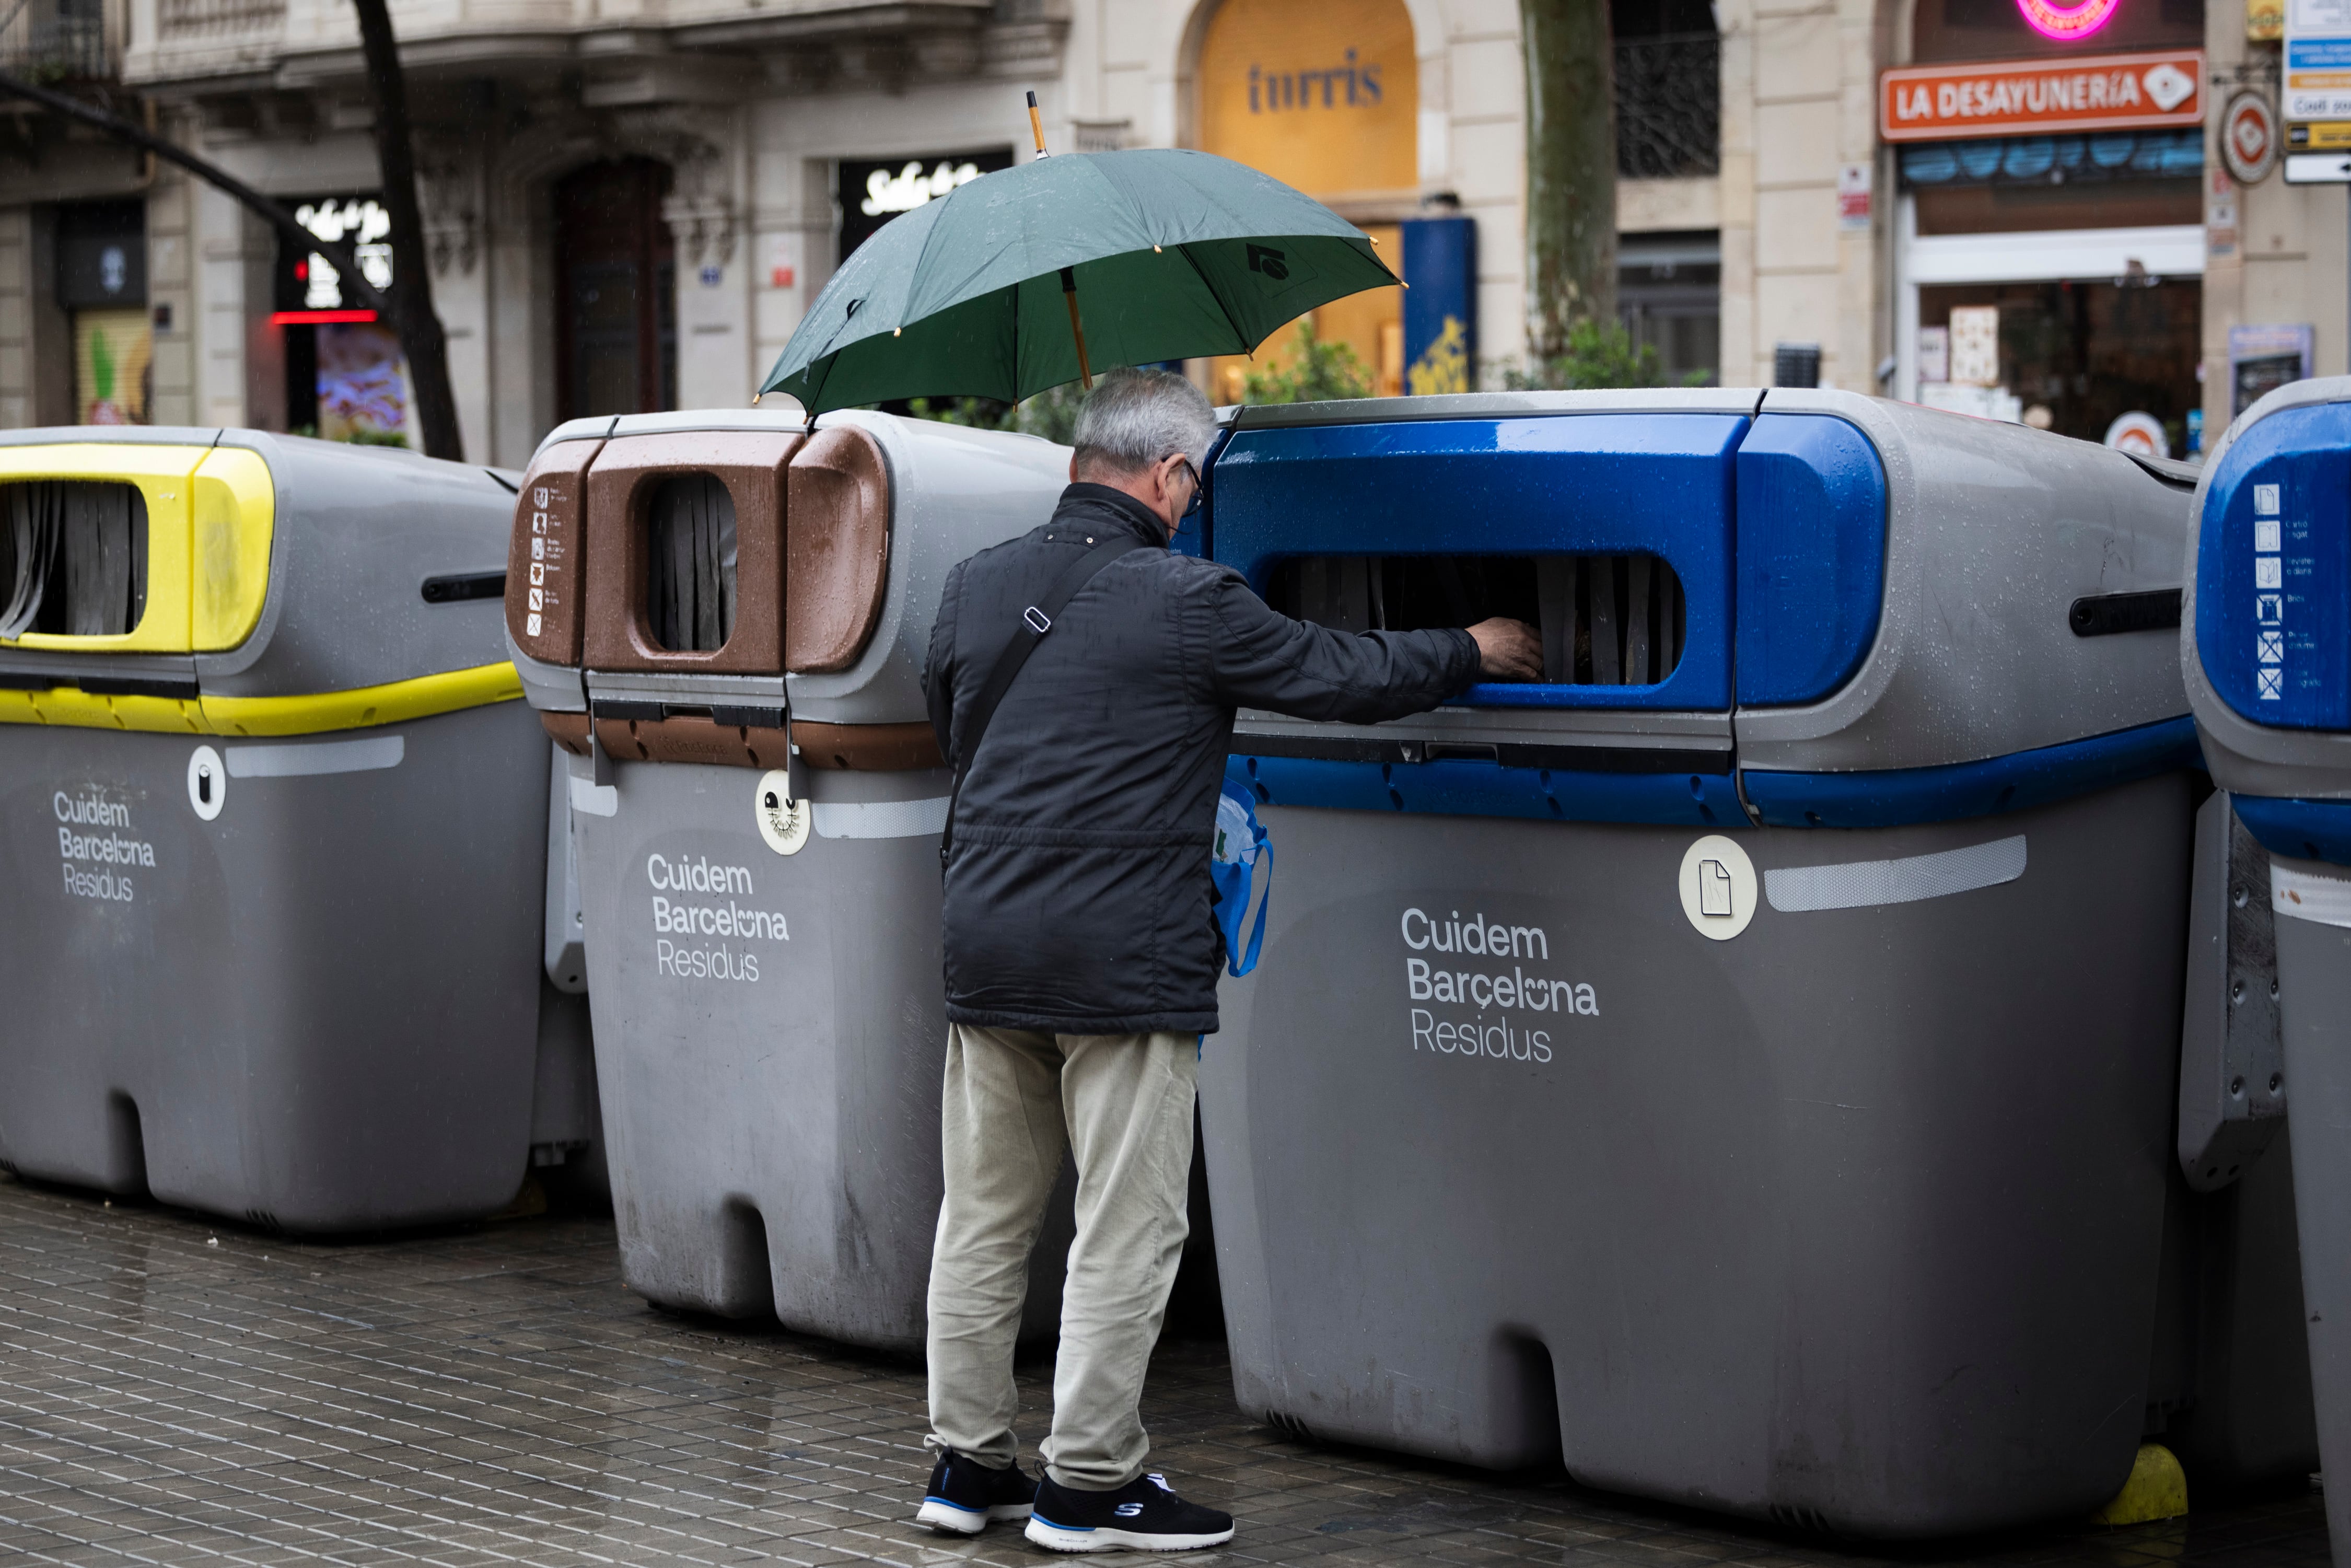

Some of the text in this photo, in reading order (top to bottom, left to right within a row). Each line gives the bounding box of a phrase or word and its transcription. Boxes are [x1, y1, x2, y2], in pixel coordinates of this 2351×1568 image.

[1896, 83, 1933, 121] LA
[54, 791, 130, 828] Cuidem
[59, 827, 156, 867] Barcelona
[63, 863, 133, 902] Residus
[647, 853, 753, 895] Cuidem
[653, 896, 789, 941] Barcelona
[1401, 908, 1548, 960] Cuidem
[657, 939, 759, 982] Residus
[1406, 958, 1599, 1017] Barcelona
[1411, 1008, 1553, 1063] Residus
